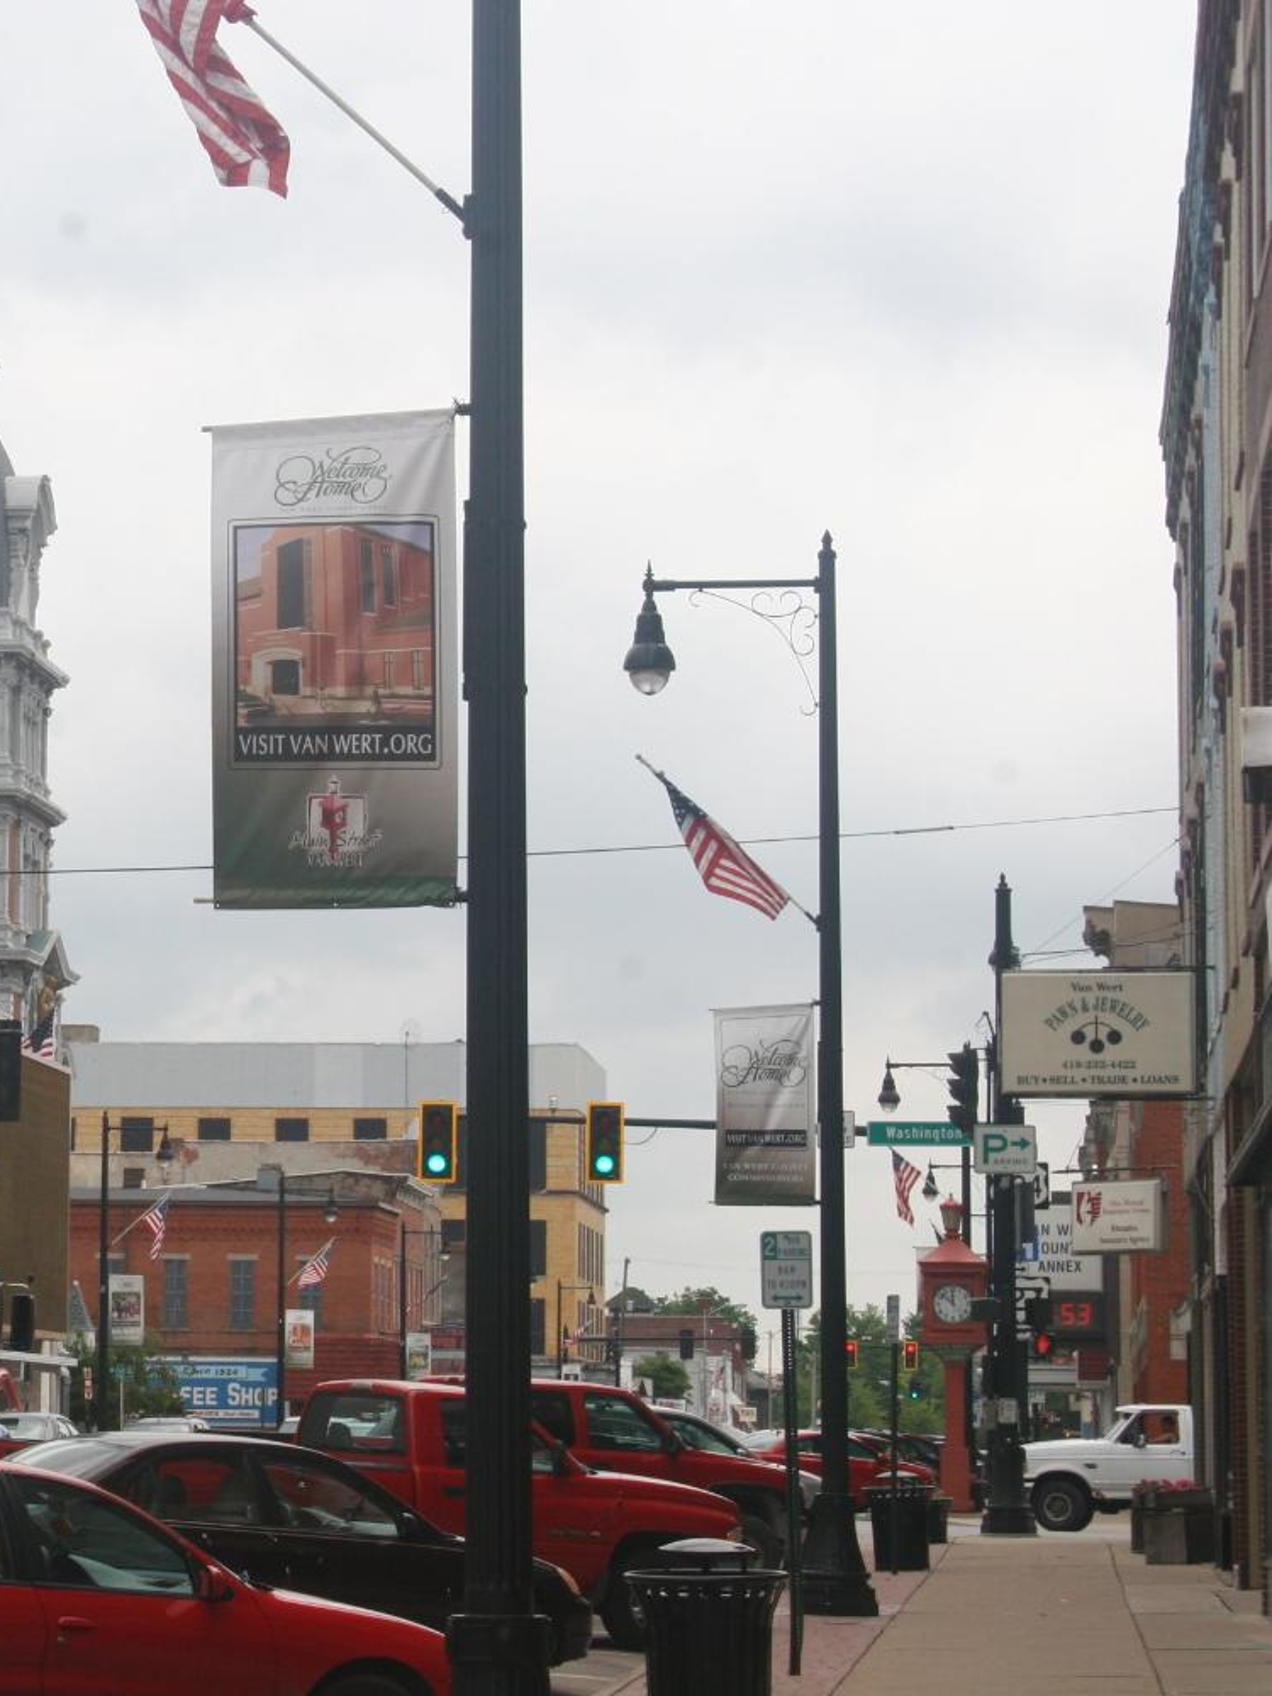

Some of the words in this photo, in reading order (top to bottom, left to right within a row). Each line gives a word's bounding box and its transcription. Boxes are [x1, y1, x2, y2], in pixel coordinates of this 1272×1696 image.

[275, 446, 390, 481] Welcome
[274, 479, 388, 506] Home
[238, 734, 286, 755] VISIT
[290, 734, 328, 755] VAN
[332, 733, 432, 755] WERT.ORG
[886, 1126, 963, 1142] Washington
[764, 1235, 775, 1257] 2
[1038, 1261, 1081, 1273] ANNEX
